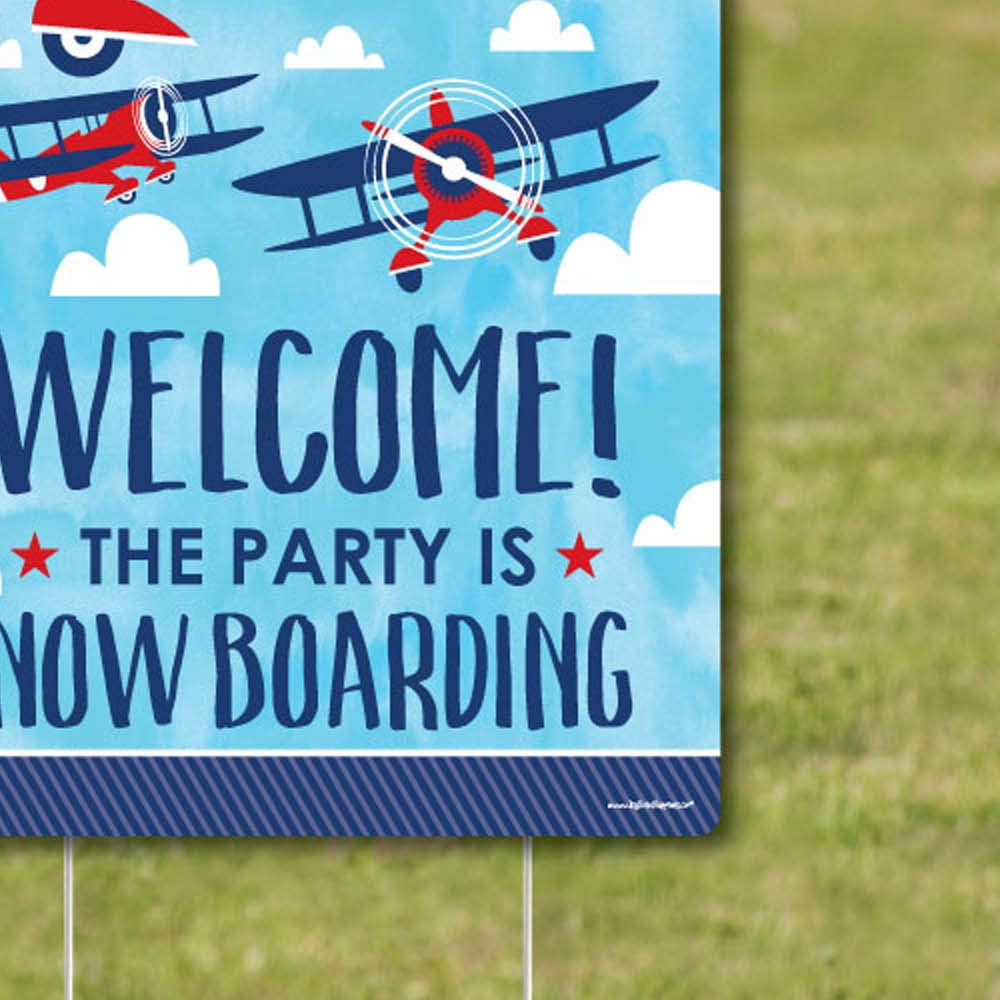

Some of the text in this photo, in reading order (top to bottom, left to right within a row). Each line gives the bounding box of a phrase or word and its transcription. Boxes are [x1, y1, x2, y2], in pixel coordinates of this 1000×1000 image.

[81, 527, 535, 586] THE PARTY IS
[213, 611, 632, 730] BOARDING
